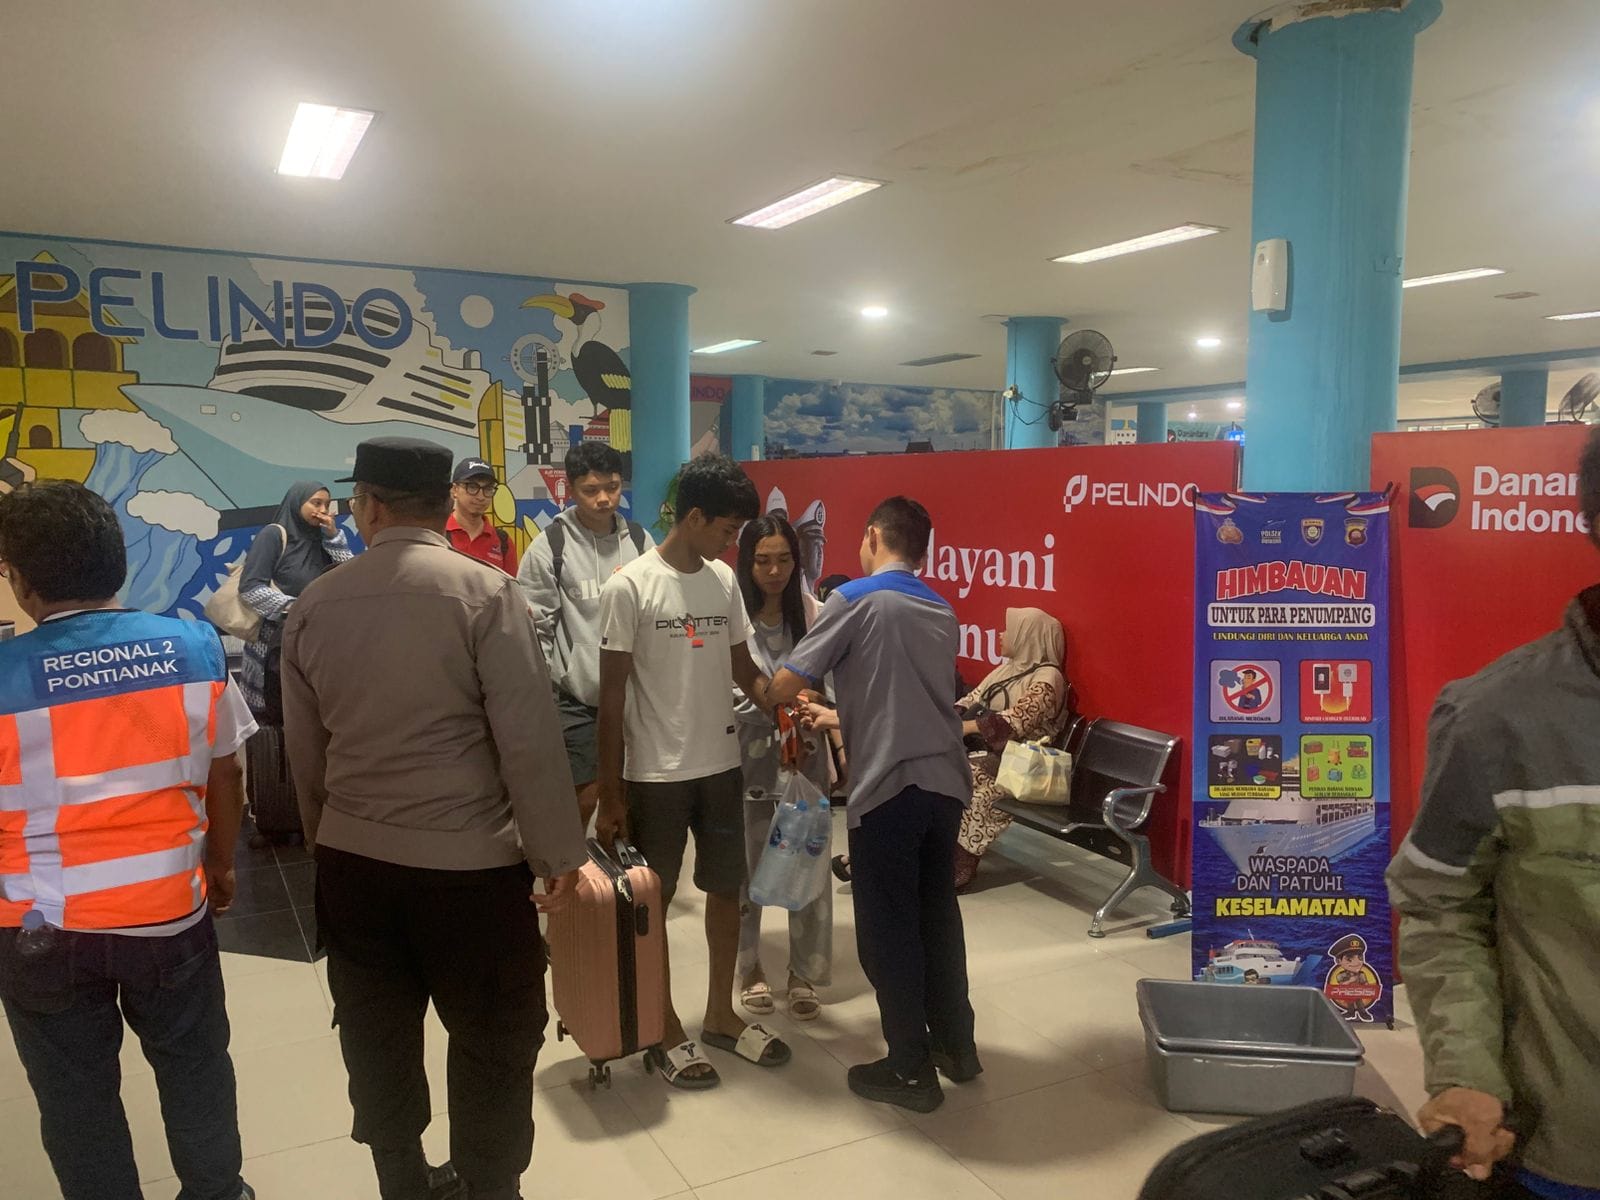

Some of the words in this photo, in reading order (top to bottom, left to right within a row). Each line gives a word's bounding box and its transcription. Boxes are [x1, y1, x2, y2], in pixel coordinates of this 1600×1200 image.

[15, 261, 413, 350] PELINDO
[1091, 483, 1200, 507] PELINDO
[914, 527, 1057, 599] layani
[1216, 560, 1367, 600] HIMBAUAN
[1211, 606, 1257, 624] UNTUK
[1257, 606, 1288, 624] PARA
[1289, 606, 1372, 624] PENUMPANG
[1213, 632, 1257, 641] LINDUNGI
[1257, 632, 1275, 641] DIRI
[1277, 632, 1294, 641] DAN
[1296, 632, 1342, 641] KELUARGA
[1344, 632, 1369, 641] ANDA
[43, 643, 159, 673] REGIONAL
[162, 640, 175, 654] 2
[47, 659, 178, 692] PONTIANAK
[1250, 858, 1330, 873] WASPADA
[1237, 876, 1270, 891] DAN
[1279, 876, 1343, 891] PATUHI
[1216, 898, 1366, 917] KESELAMATAN
